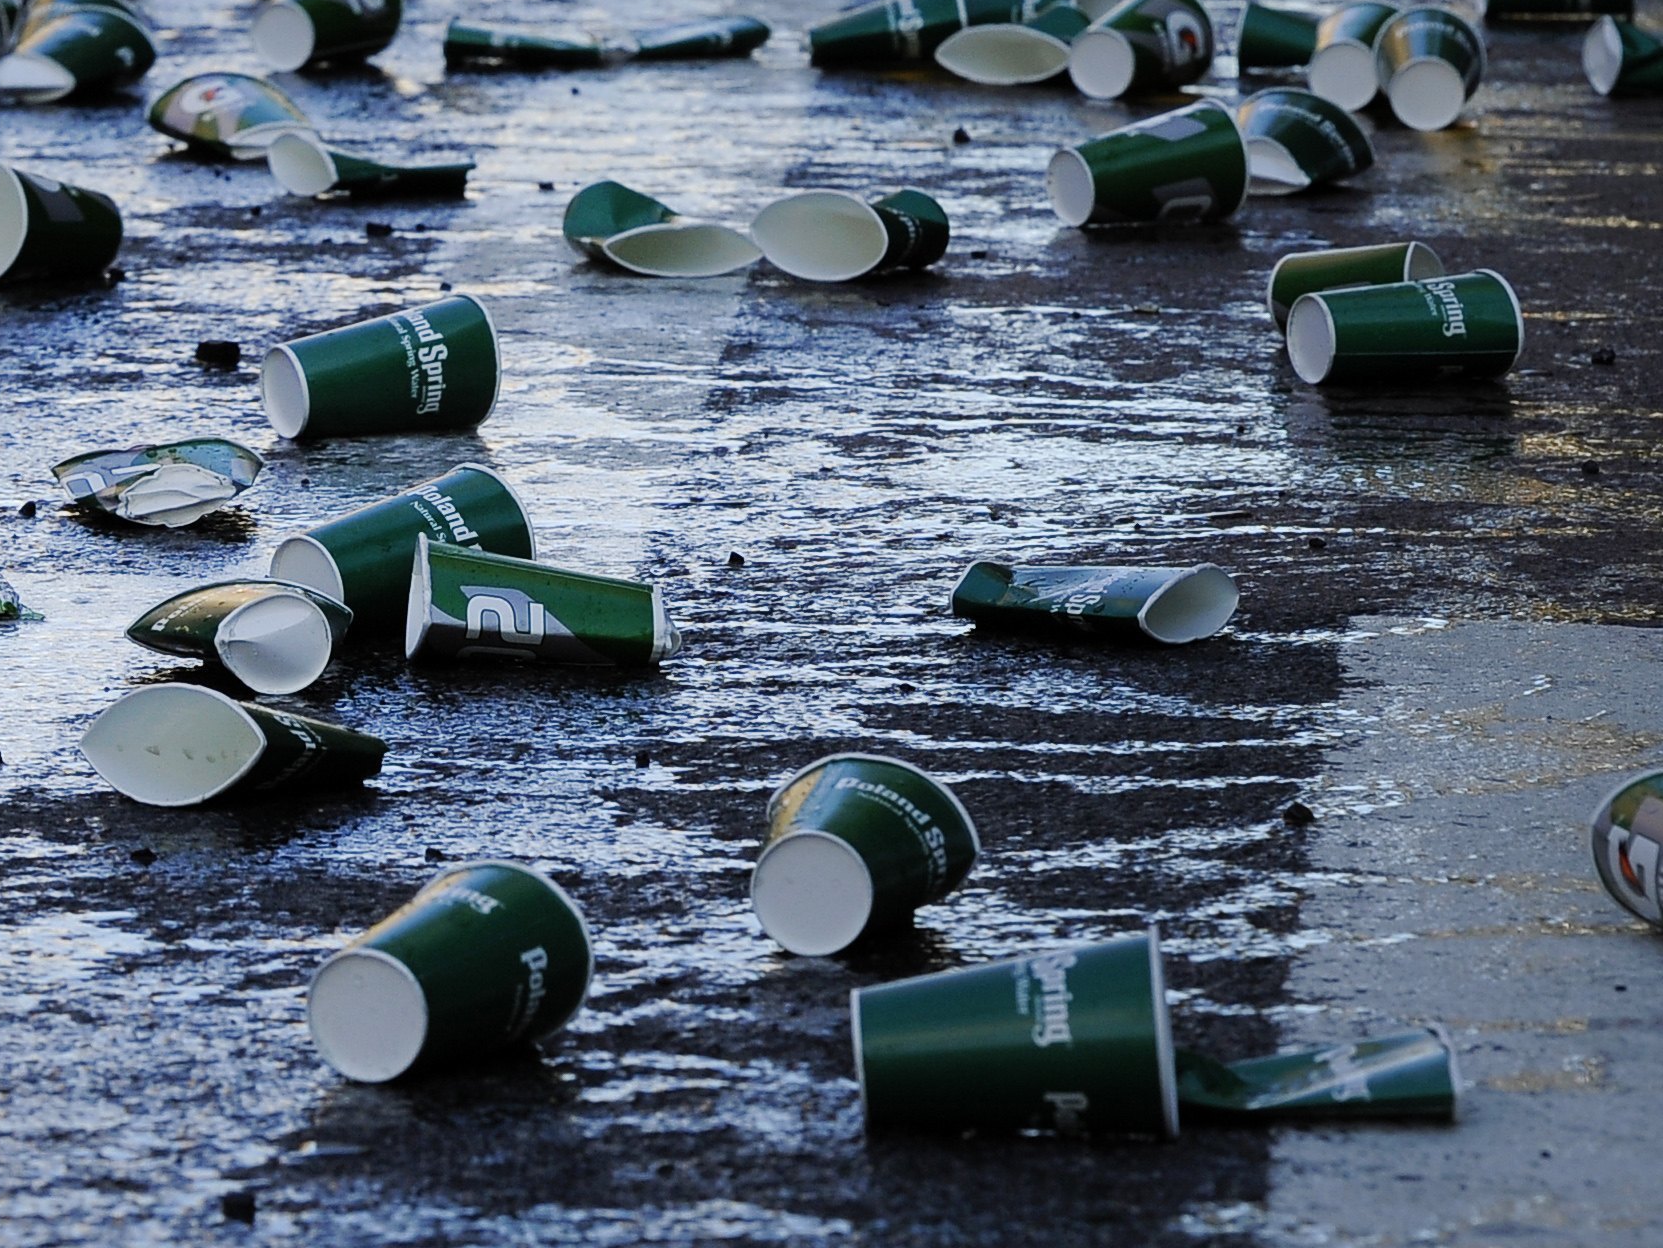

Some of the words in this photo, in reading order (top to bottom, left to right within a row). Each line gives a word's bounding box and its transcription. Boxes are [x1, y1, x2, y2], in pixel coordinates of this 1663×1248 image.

[1425, 281, 1467, 338] Spring
[417, 343, 448, 414] Spring
[407, 484, 479, 542] Poland
[409, 500, 442, 531] Natural
[835, 776, 931, 826] Poland
